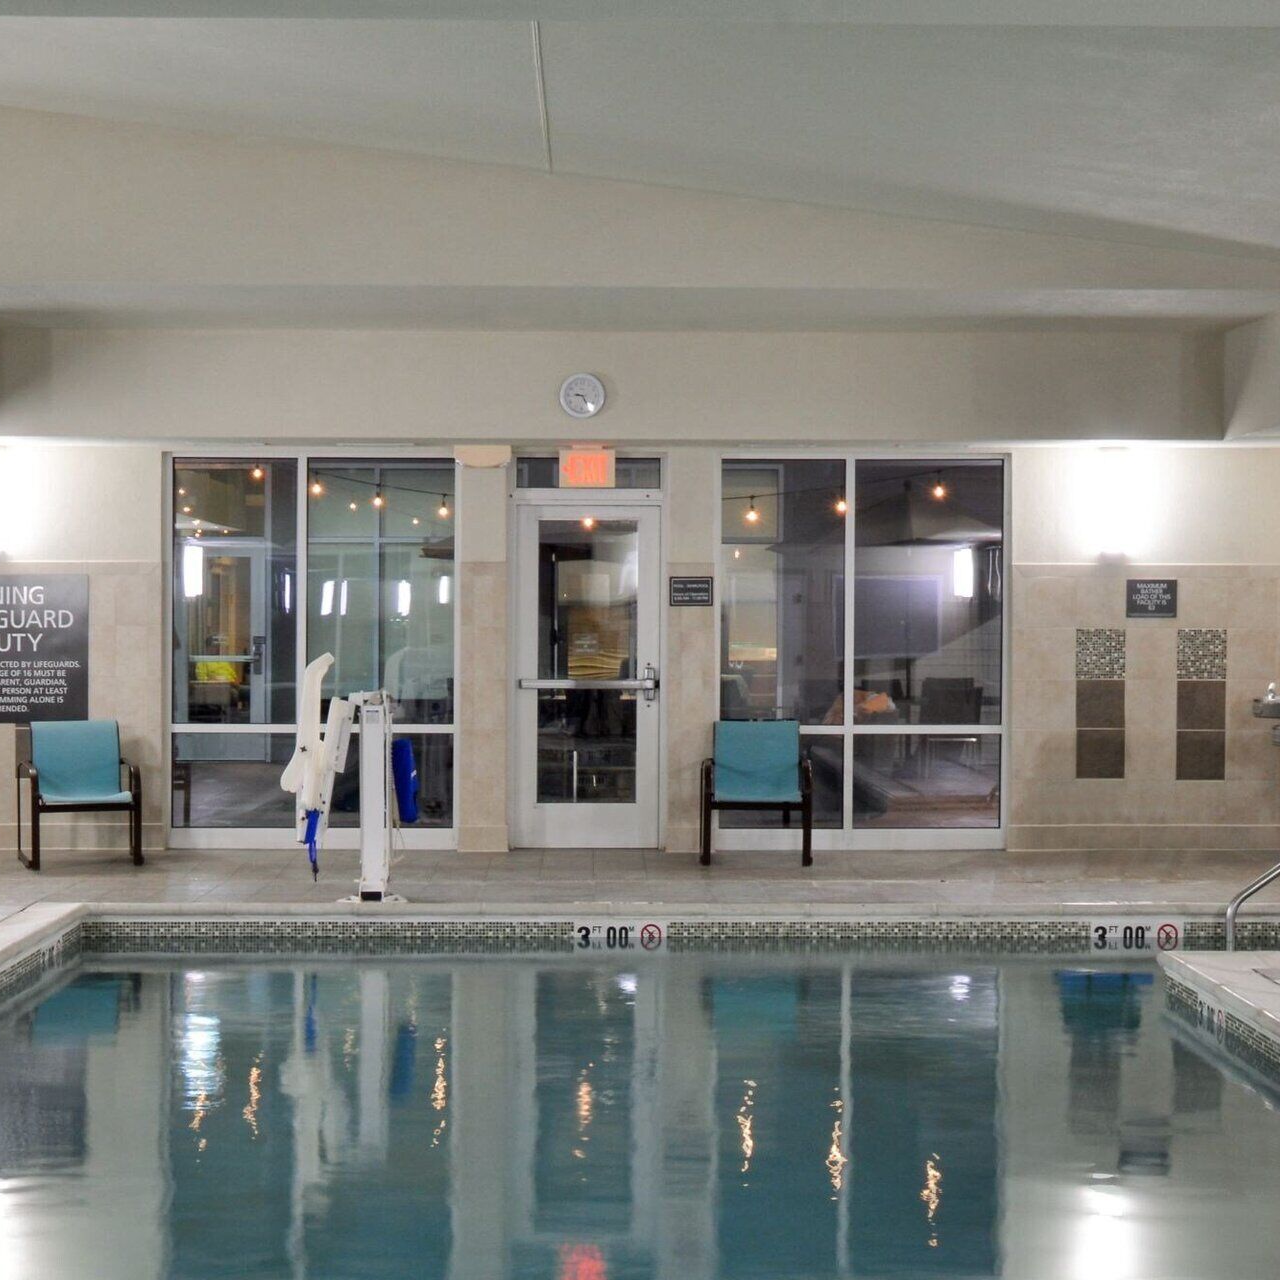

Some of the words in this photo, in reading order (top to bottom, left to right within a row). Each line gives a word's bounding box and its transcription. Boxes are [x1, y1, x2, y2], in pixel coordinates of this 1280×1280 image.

[569, 454, 608, 483] EXIT
[577, 926, 591, 946] 3
[1093, 926, 1107, 946] 3
